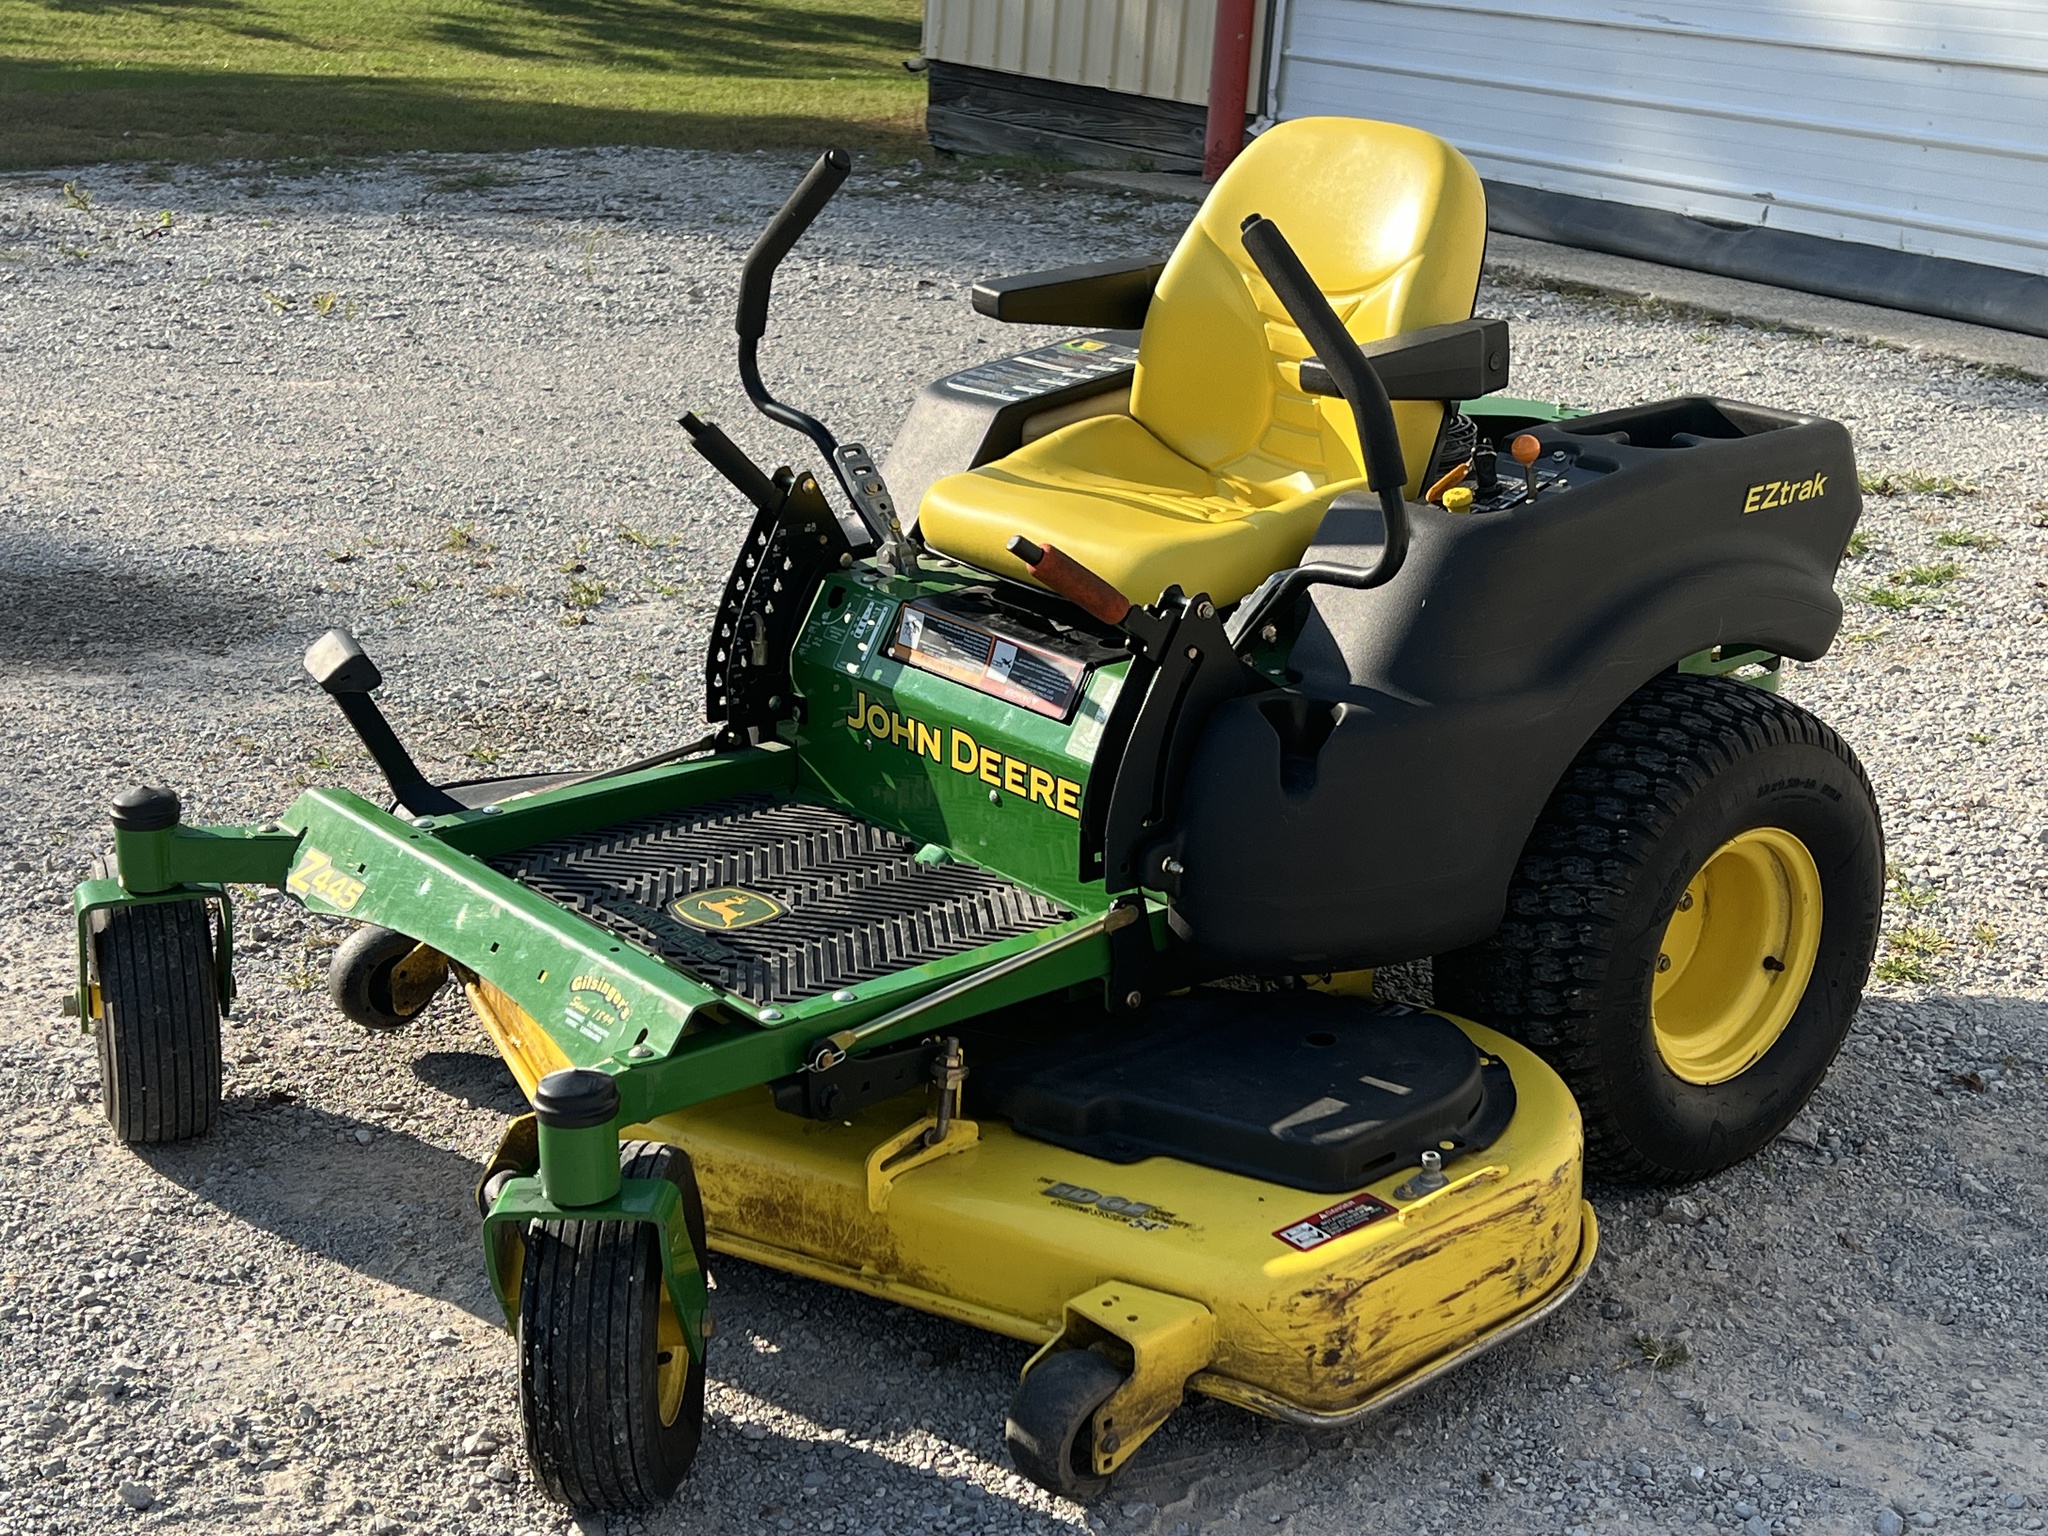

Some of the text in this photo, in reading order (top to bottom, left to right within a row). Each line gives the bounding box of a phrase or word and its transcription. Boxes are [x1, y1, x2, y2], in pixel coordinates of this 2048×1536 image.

[1742, 471, 1829, 514] EZtrak
[847, 691, 1082, 819] JOHN DEERE
[288, 850, 364, 909] Z445
